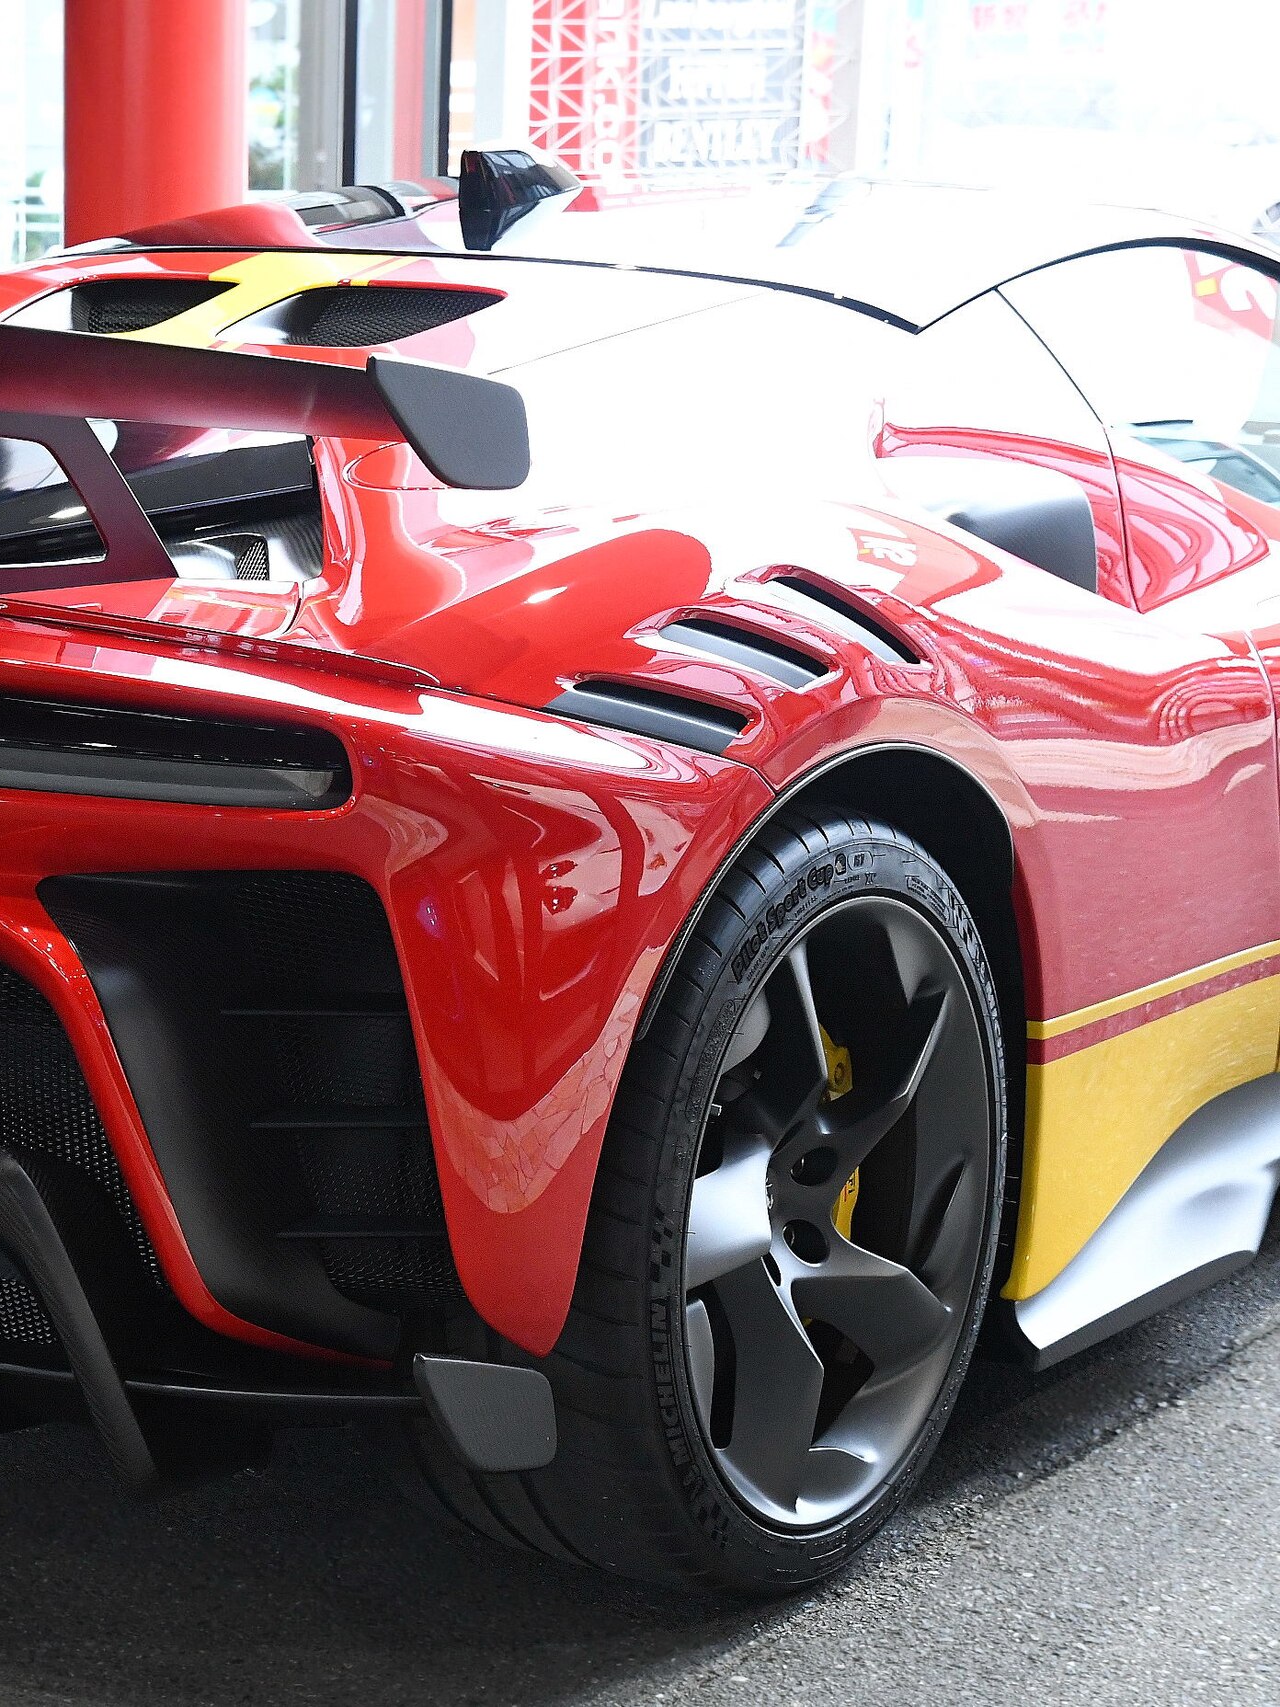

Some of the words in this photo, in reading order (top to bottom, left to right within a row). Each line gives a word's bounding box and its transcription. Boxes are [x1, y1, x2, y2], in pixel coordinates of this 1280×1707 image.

[731, 921, 769, 984] Pilot
[766, 877, 807, 933] Sport
[807, 864, 834, 891] Cup
[650, 1301, 691, 1468] MICHELIN
